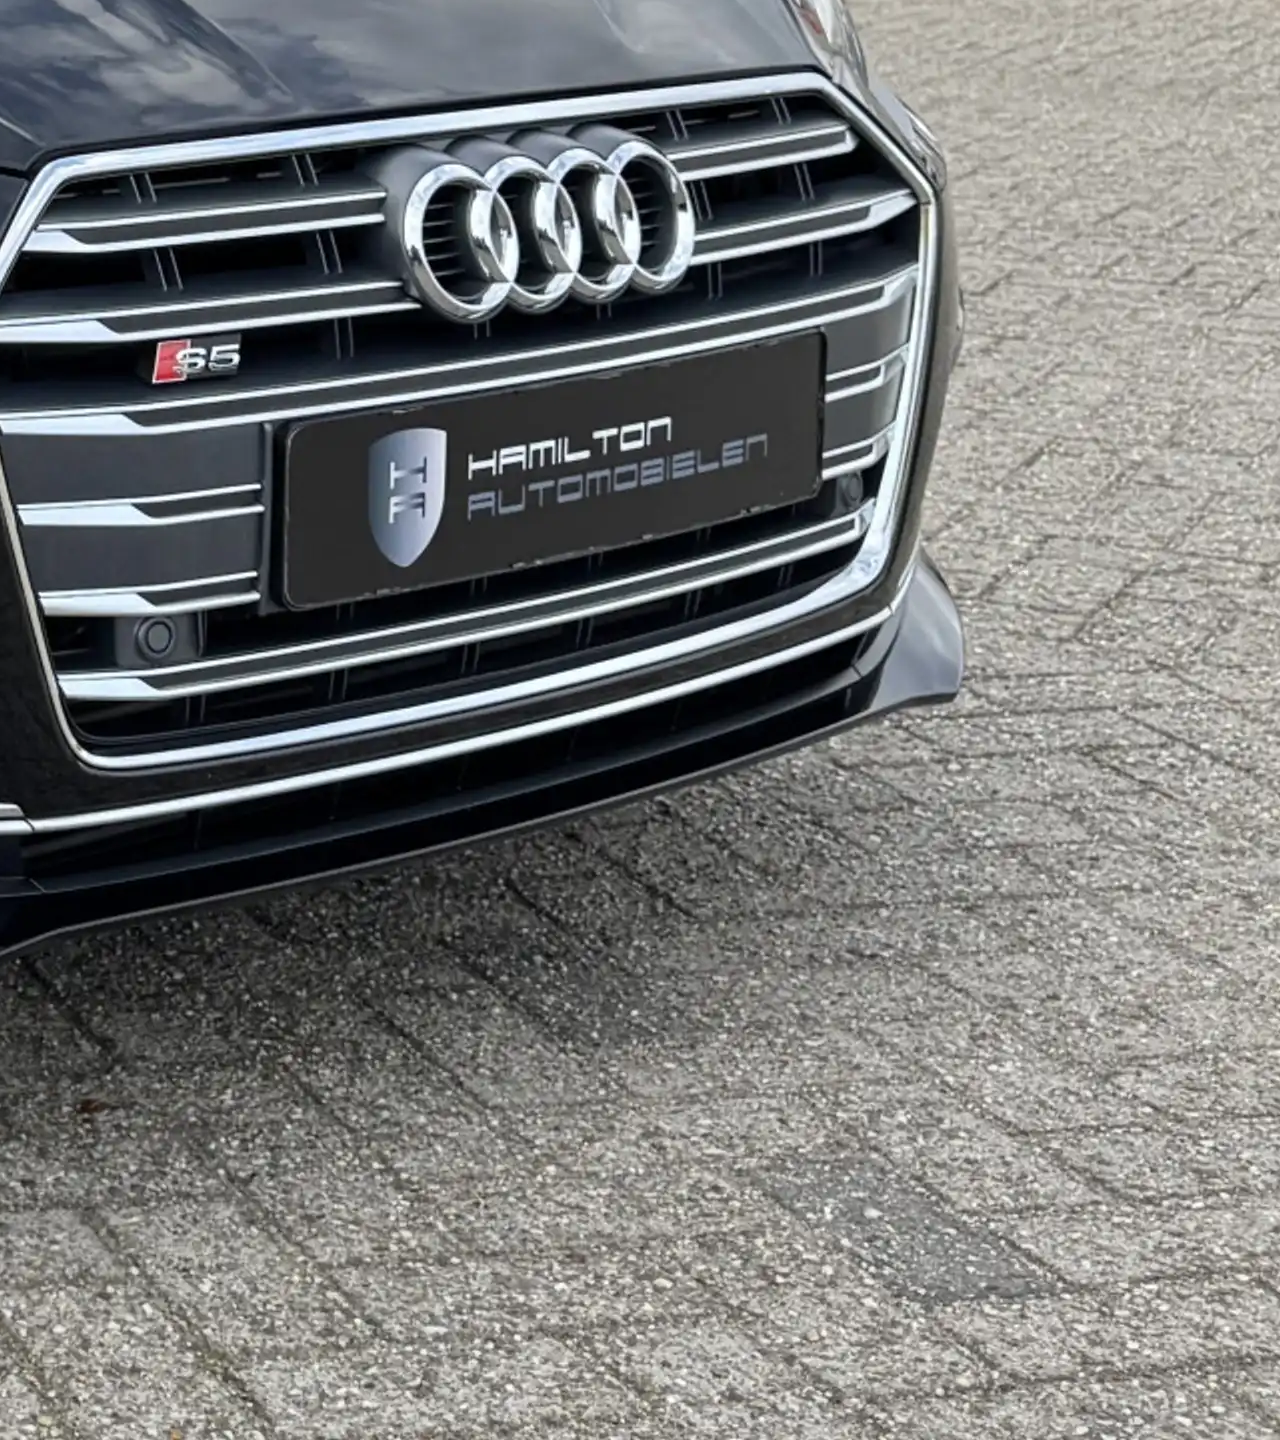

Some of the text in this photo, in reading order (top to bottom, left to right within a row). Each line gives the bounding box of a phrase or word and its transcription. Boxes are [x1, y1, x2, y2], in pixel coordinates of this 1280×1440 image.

[174, 343, 241, 374] S5
[466, 433, 768, 522] AUTOMOBIELEN
[467, 416, 672, 481] HAMILTON
